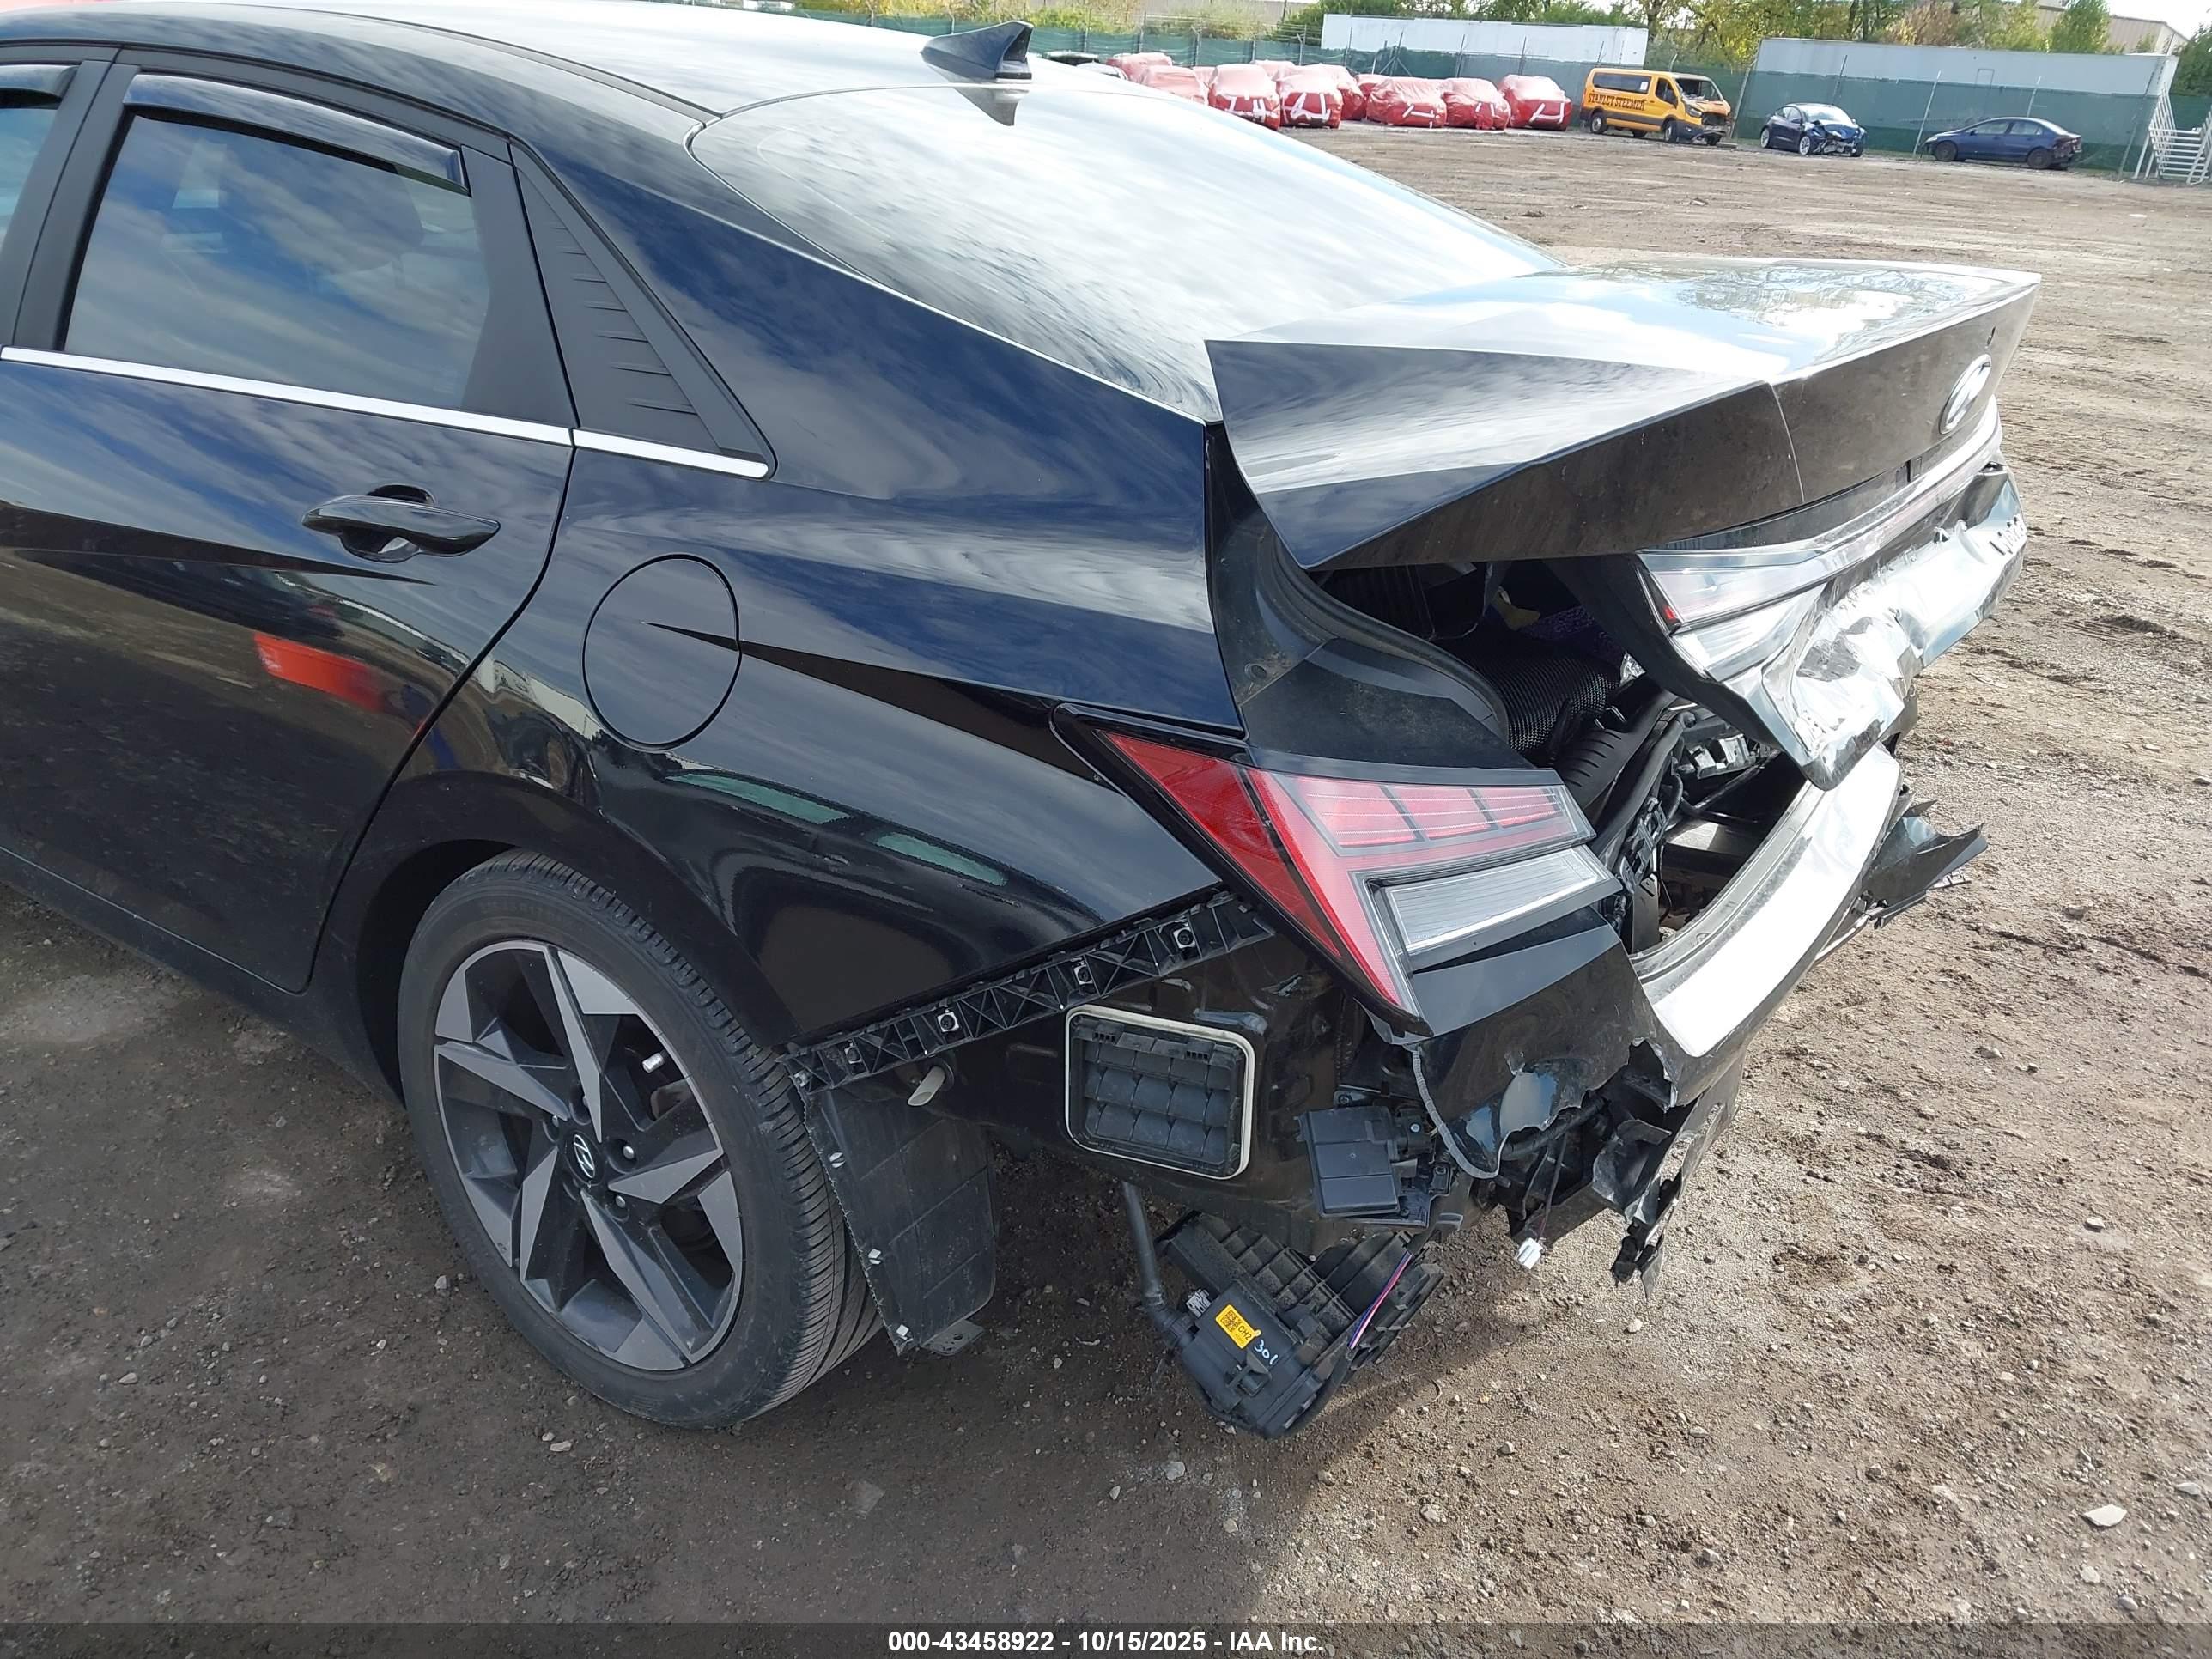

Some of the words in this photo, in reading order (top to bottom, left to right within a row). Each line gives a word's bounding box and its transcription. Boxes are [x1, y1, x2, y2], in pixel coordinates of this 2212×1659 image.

[1588, 93, 1615, 106] STANLEY
[1615, 96, 1647, 111] STEEMER
[1237, 1325, 1252, 1341] CH2
[1254, 1339, 1279, 1365] 301
